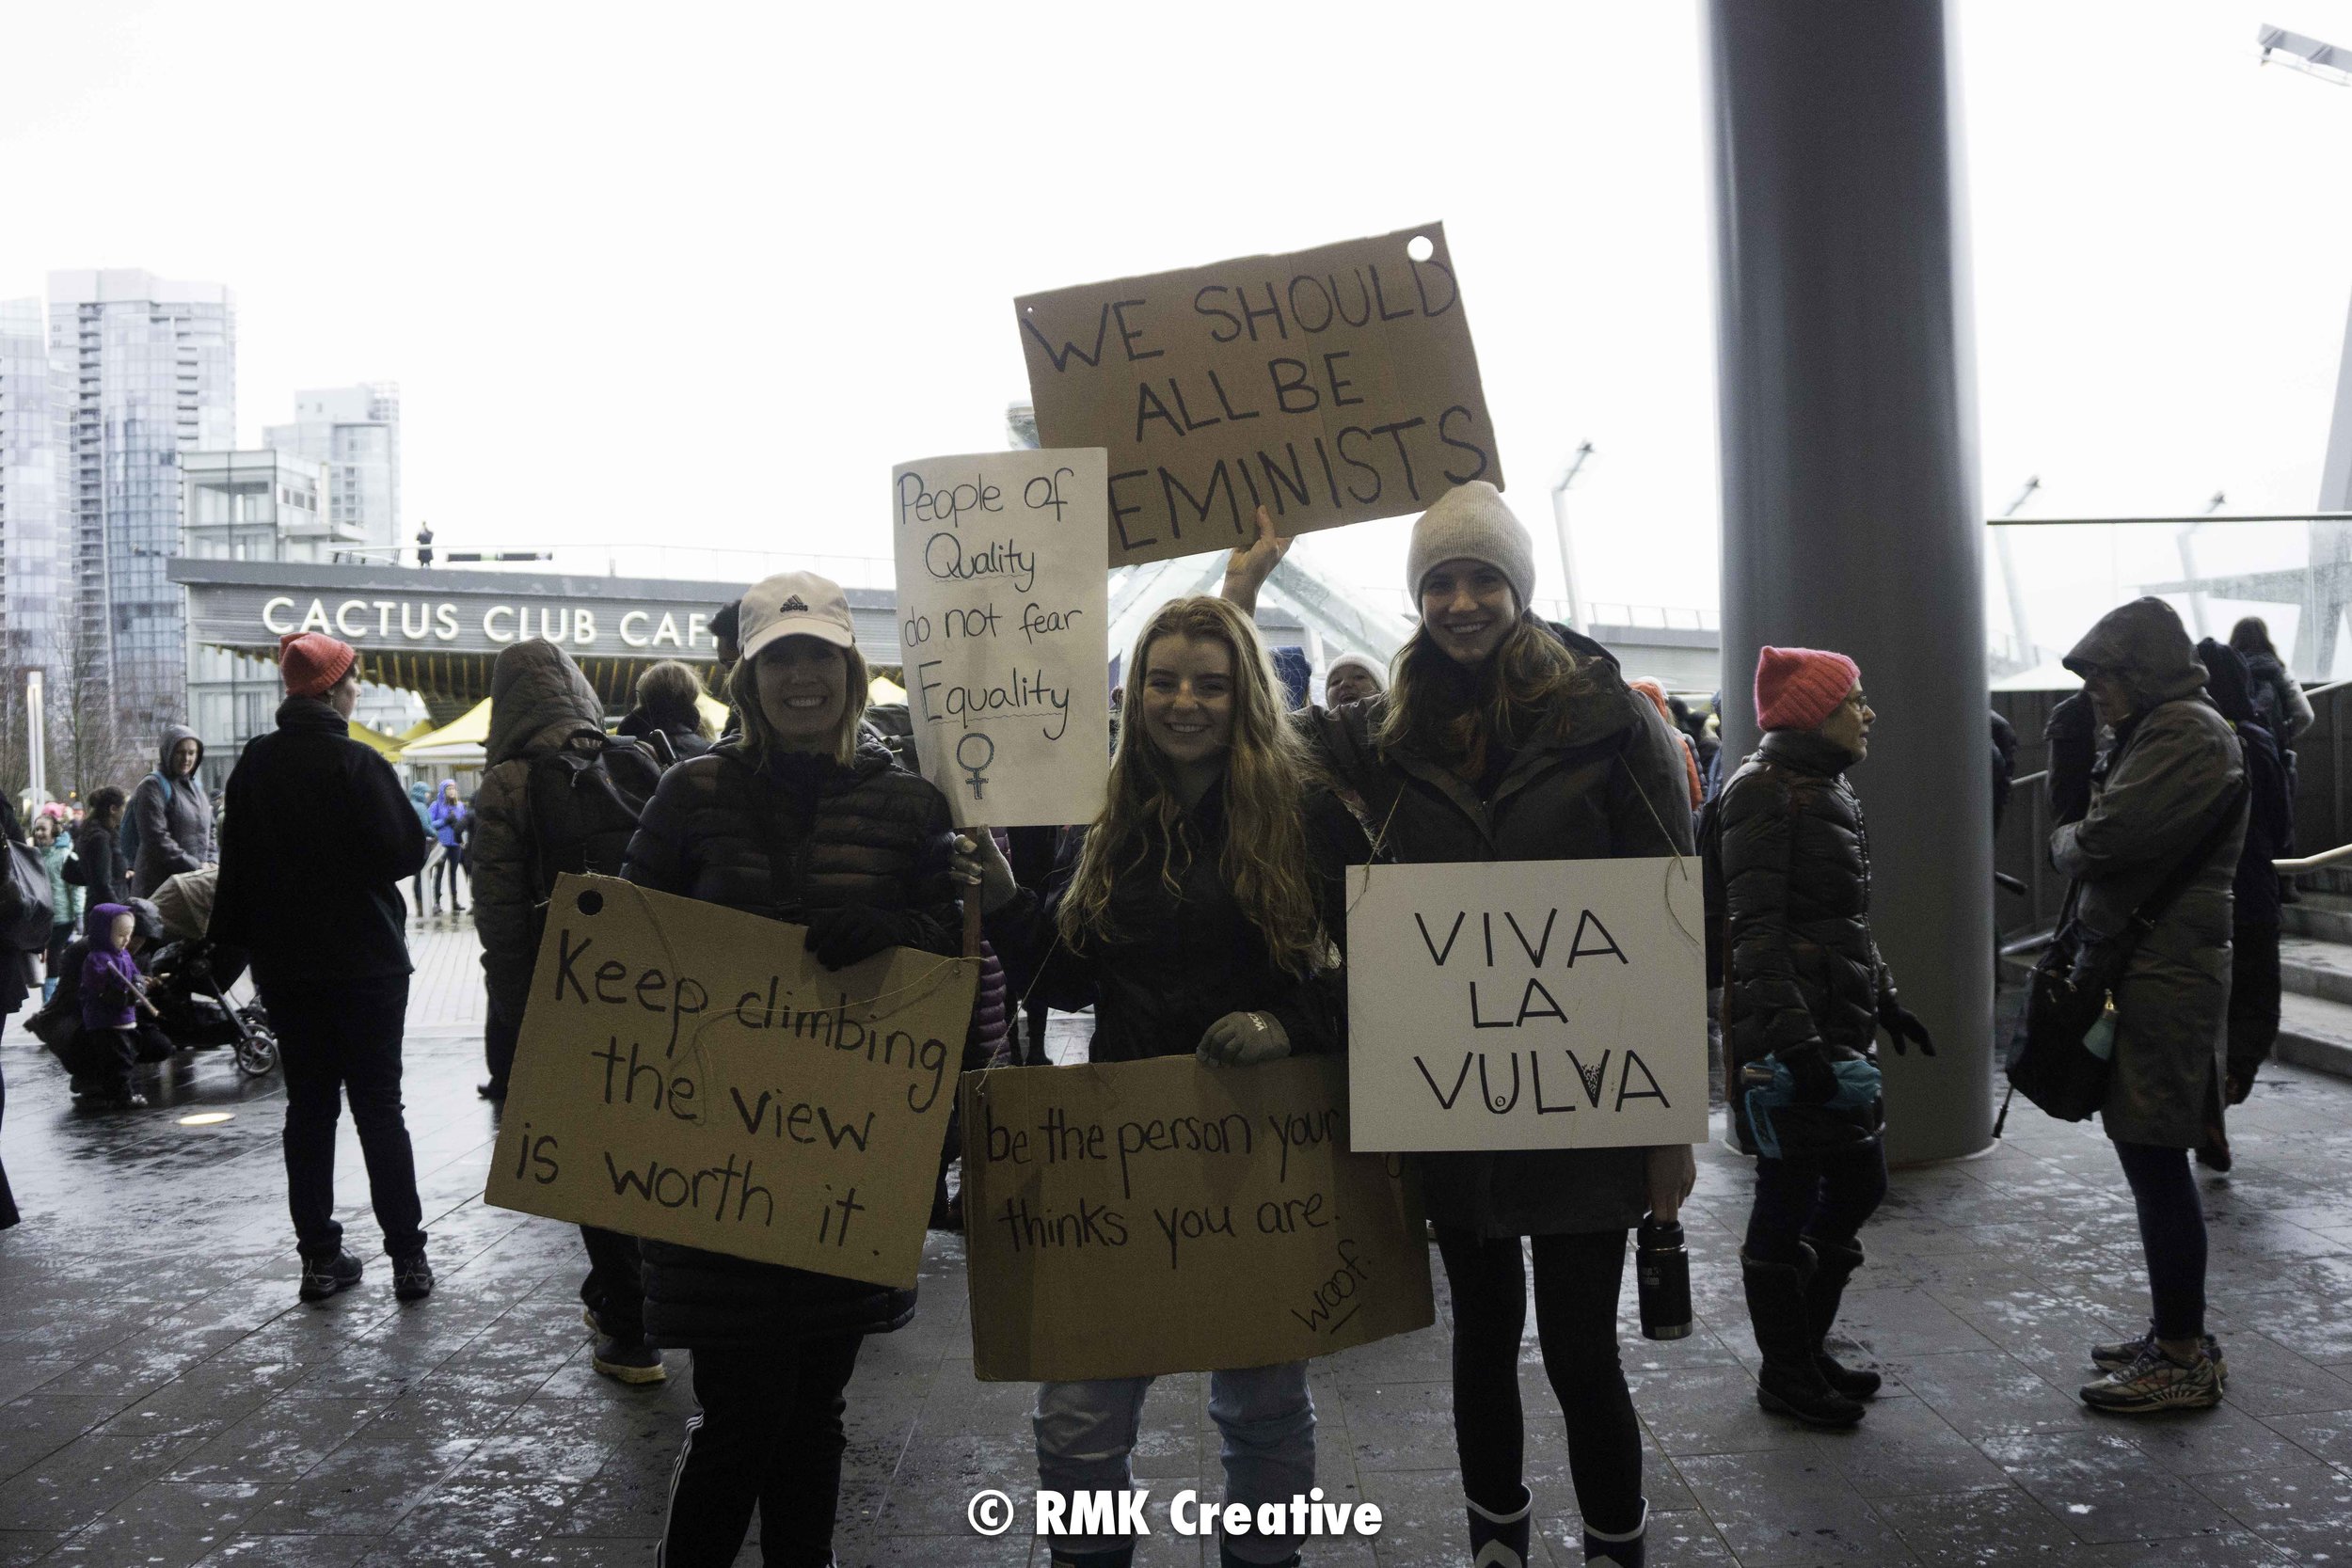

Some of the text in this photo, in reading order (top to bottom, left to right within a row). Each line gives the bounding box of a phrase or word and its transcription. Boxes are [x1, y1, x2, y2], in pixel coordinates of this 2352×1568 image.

[1021, 259, 1458, 372] WE SHOULD
[1136, 350, 1364, 443] ALL BE
[897, 471, 1004, 529] People
[1107, 404, 1488, 551] EMINISTS
[923, 531, 1036, 594] Quality
[262, 596, 460, 641] CACTUS
[482, 605, 598, 645] CLUB
[903, 602, 1083, 648] do not fear
[918, 659, 1070, 741] Equality
[1414, 907, 1629, 969] VIVA
[555, 928, 947, 1114] Keep climbing
[1469, 977, 1569, 1028] LA
[591, 1036, 876, 1152] the view
[1412, 1048, 1672, 1116] VULVA
[516, 1123, 560, 1184] is
[604, 1152, 774, 1227] worth
[985, 1103, 1341, 1199] be the person your
[997, 1192, 1342, 1270] thinks you are.
